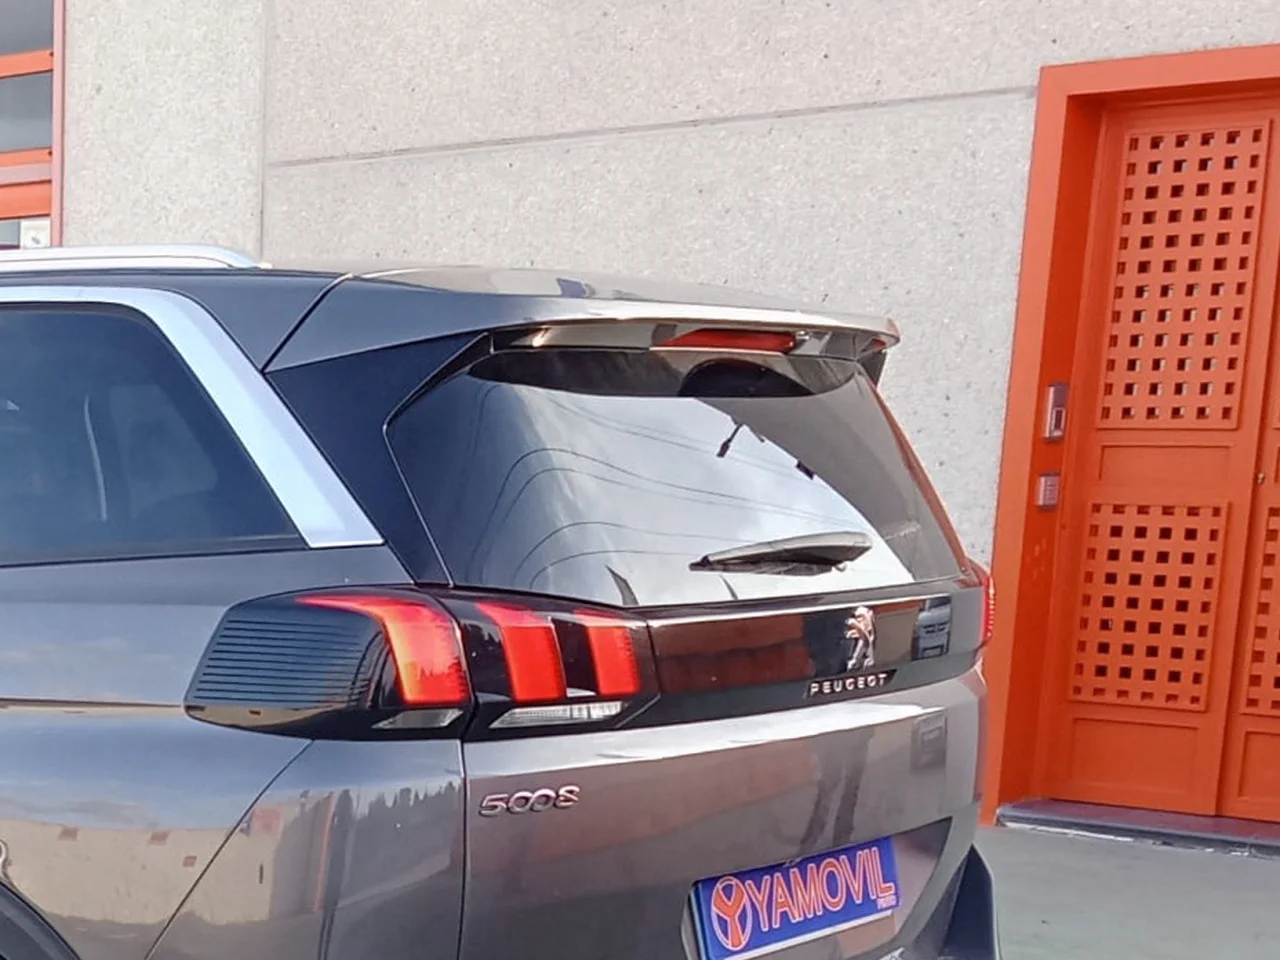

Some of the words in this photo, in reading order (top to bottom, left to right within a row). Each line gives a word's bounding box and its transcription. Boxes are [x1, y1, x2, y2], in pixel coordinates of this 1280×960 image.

[810, 673, 887, 697] PEUGEOT
[480, 785, 580, 816] 5008
[746, 847, 895, 932] YAMOVIL
